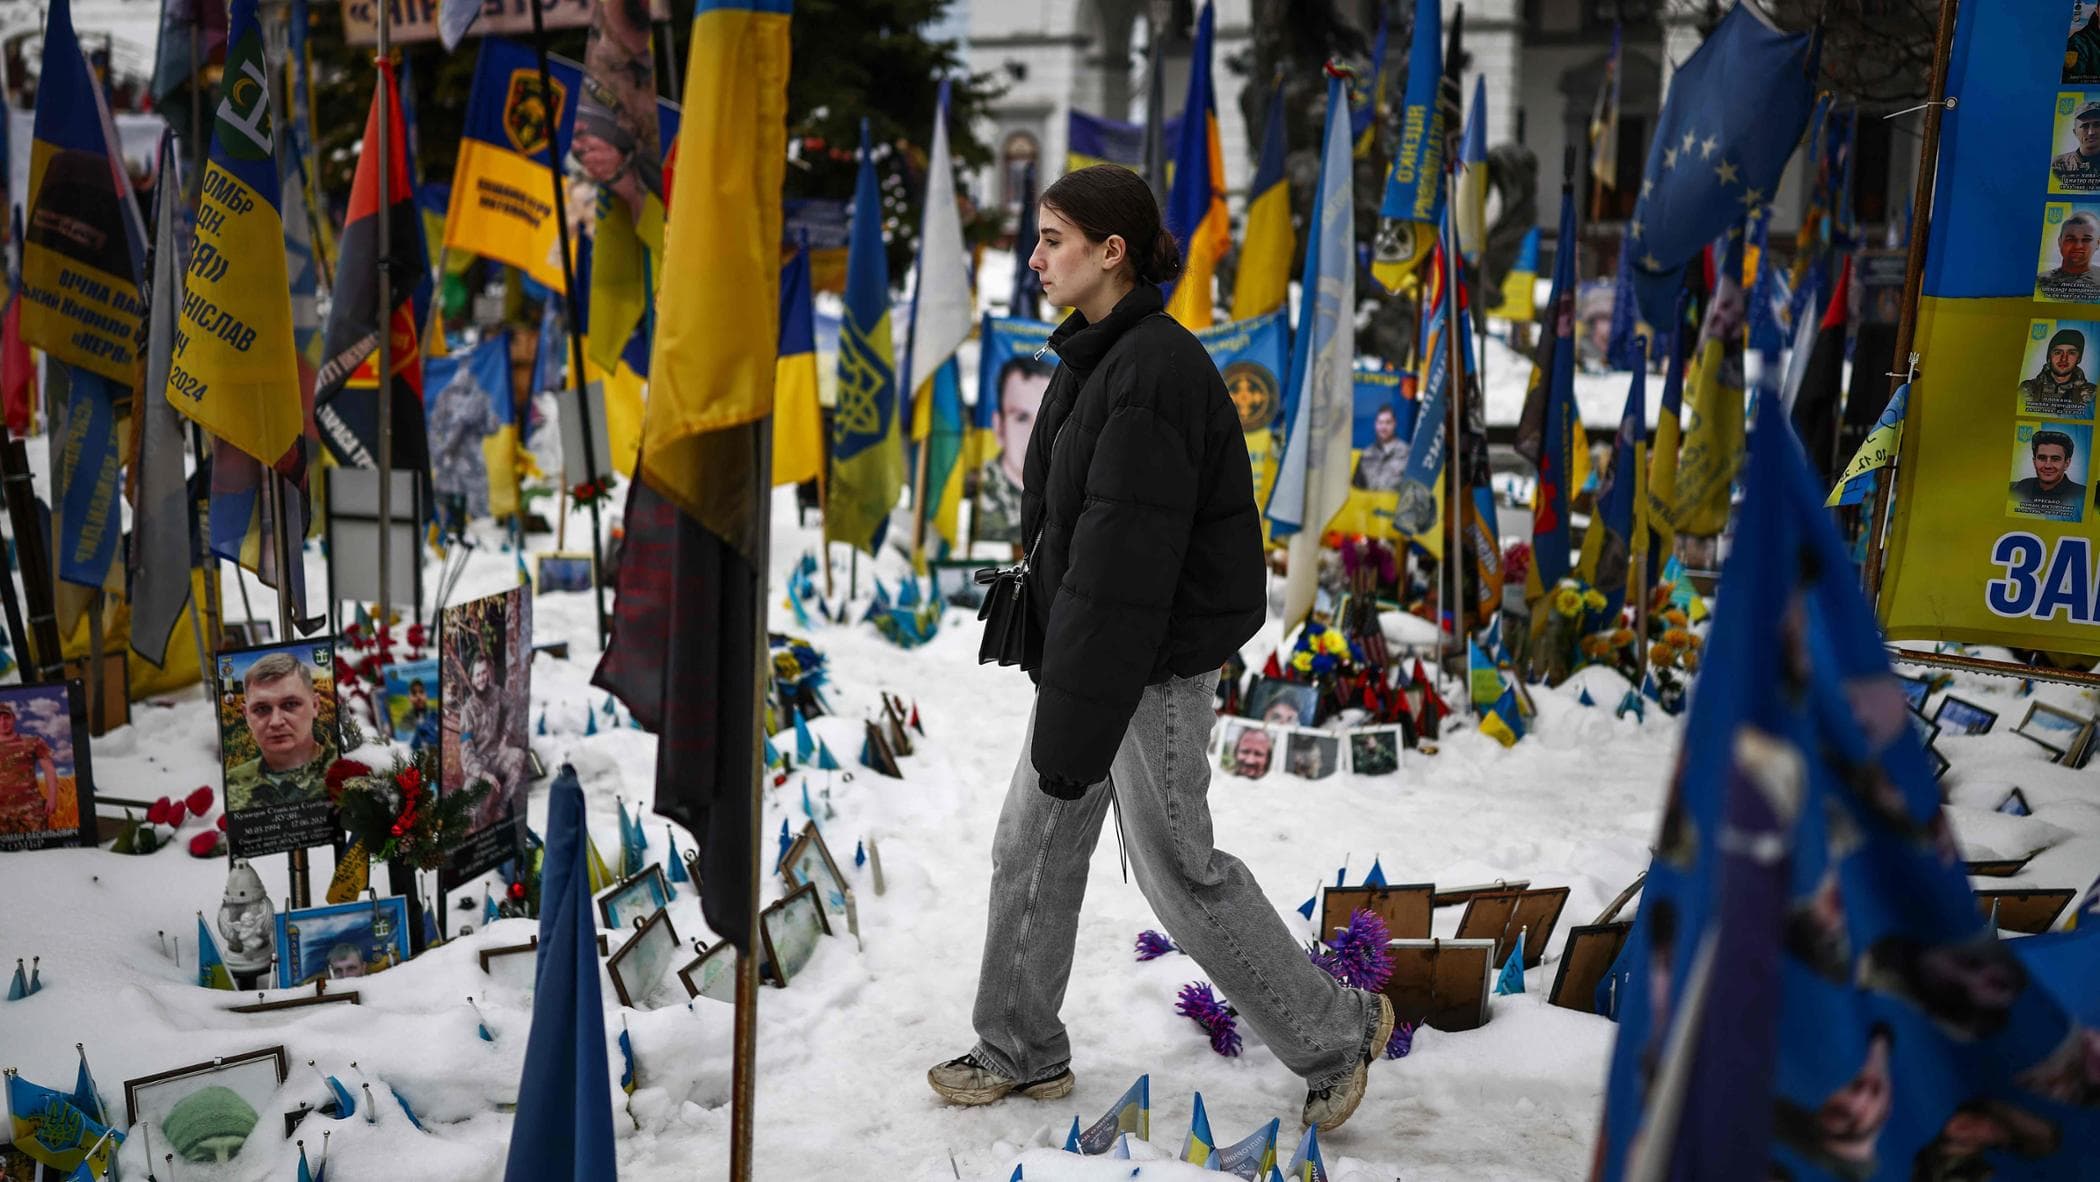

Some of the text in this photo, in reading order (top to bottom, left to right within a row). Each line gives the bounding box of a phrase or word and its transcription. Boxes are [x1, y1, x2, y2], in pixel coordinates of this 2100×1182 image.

[203, 169, 255, 216] ОМБР
[169, 366, 209, 403] 2024
[1985, 531, 2100, 626] ЗА
